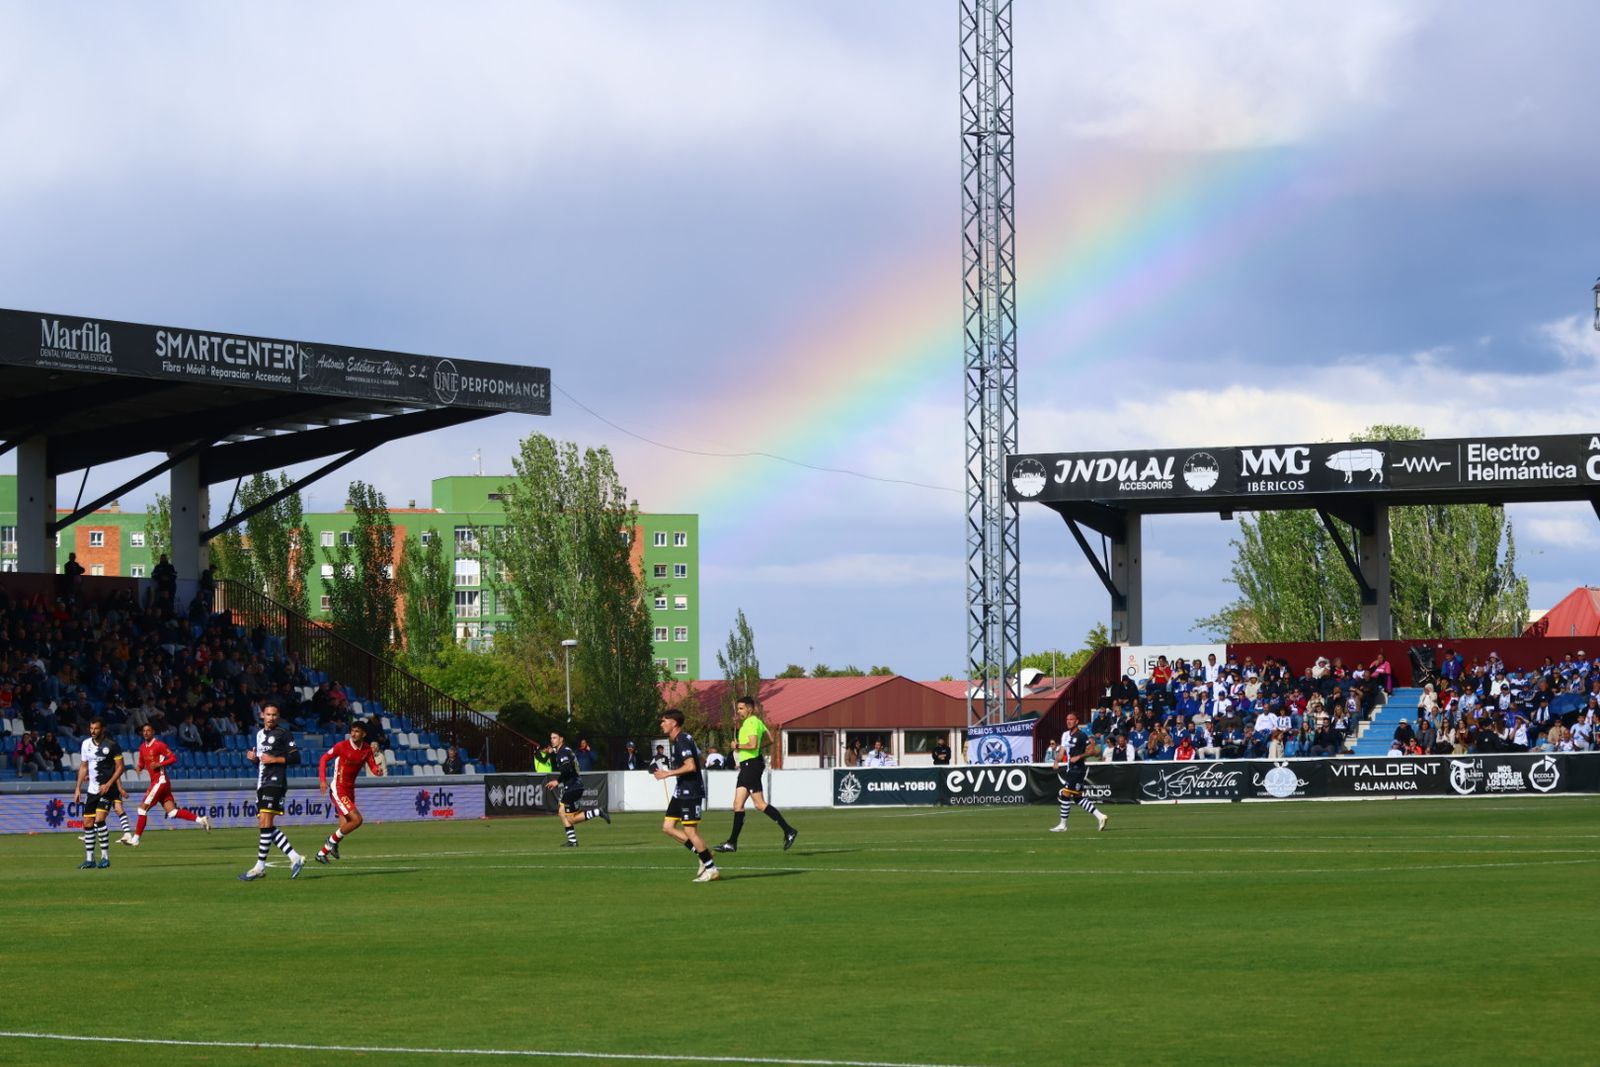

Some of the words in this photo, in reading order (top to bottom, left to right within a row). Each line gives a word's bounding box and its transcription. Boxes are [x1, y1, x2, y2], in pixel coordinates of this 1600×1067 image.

[41, 318, 112, 354] Marfila
[155, 330, 295, 370] SMARTCENTER
[162, 361, 181, 372] Fibra
[186, 363, 206, 375] Móvil
[210, 365, 250, 379] Reparación
[255, 370, 291, 383] Accesorios
[461, 376, 545, 398] PERFORMANCE
[1240, 447, 1311, 476] MMG
[1468, 443, 1540, 462] Electro
[1054, 457, 1175, 483] INDUAL
[1468, 461, 1577, 481] Helmántica
[1119, 481, 1173, 491] ACCESORIOS
[1247, 480, 1305, 492] IBÉRICOS
[1331, 763, 1440, 776] VITALDENT
[867, 781, 937, 792] CLIMA-TOBIO
[947, 769, 1027, 792] evvo
[1354, 781, 1418, 791] SALAMANCA
[432, 787, 453, 807] chc
[950, 794, 1025, 805] evvohome.com
[209, 804, 224, 818] en
[227, 802, 239, 817] tu
[288, 801, 303, 815] de
[306, 799, 322, 815] luz
[325, 803, 332, 818] y
